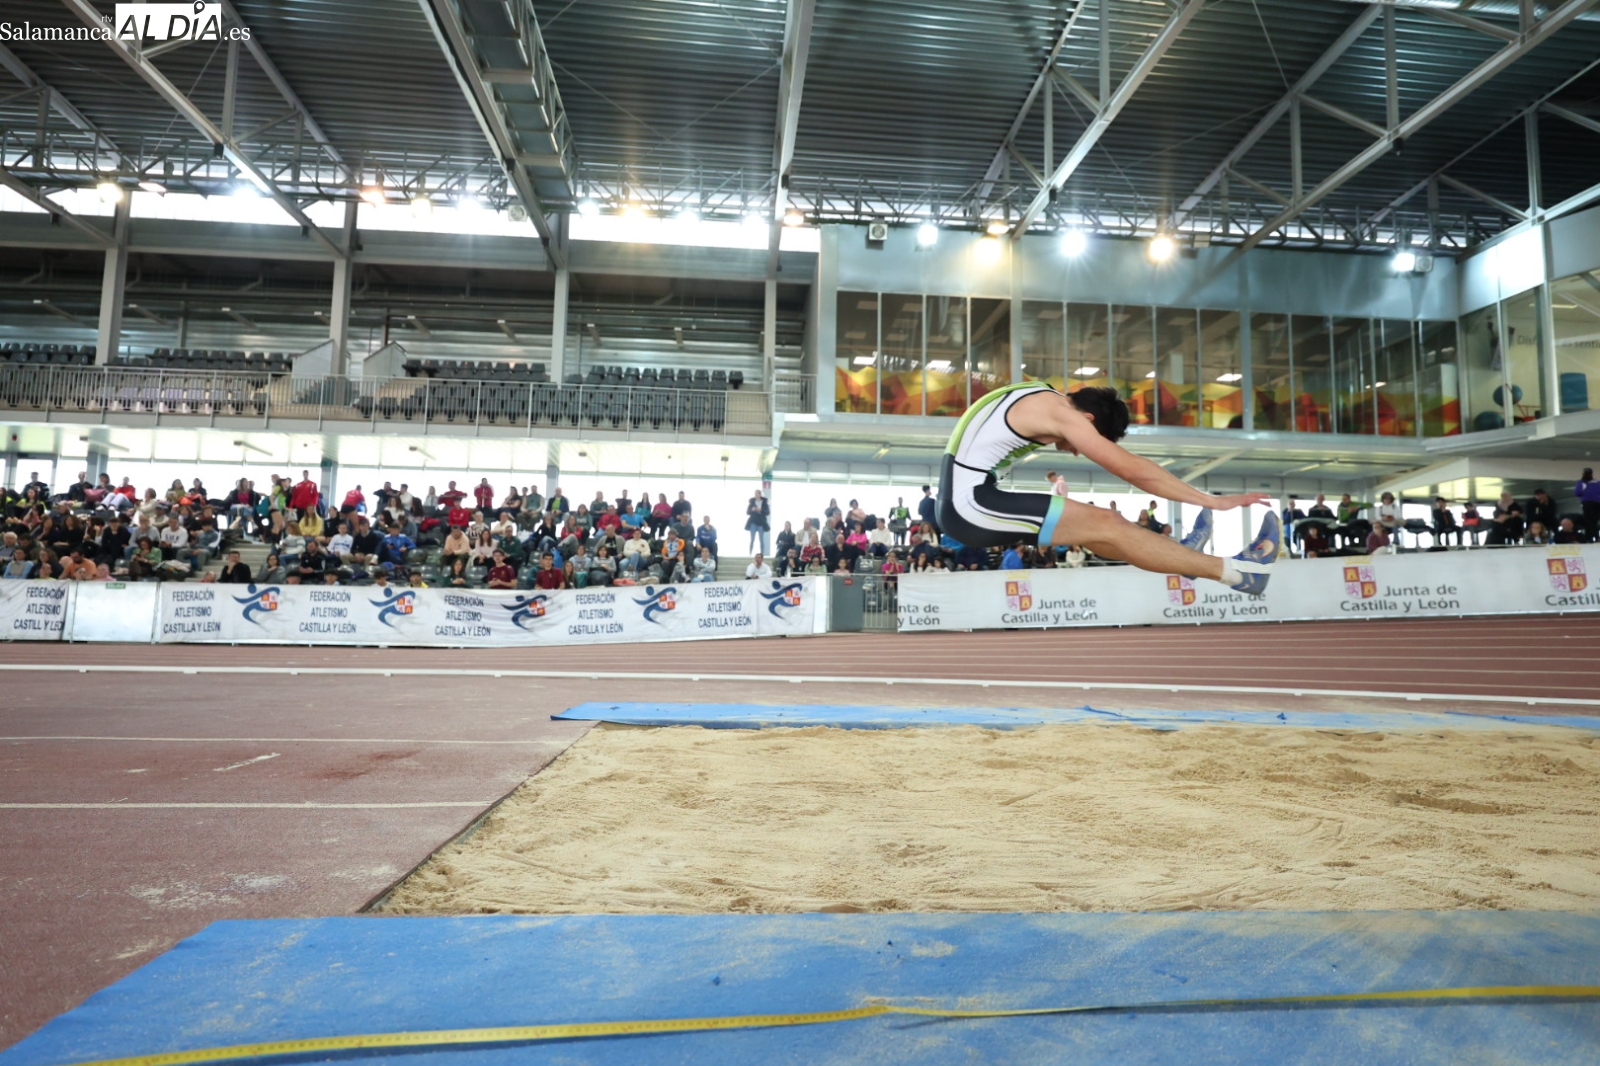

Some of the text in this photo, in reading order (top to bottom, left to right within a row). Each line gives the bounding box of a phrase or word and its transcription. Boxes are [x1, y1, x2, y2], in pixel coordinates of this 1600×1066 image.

[172, 588, 215, 602] FEDERACIÓN
[309, 589, 351, 602] FEDERACIÓN
[704, 585, 743, 598] FEDERACIÓN
[1383, 584, 1458, 597] Junta de
[444, 595, 484, 607] FEDERACIÓN
[576, 591, 616, 604] FEDERACIÓN
[1037, 598, 1096, 610] Junta de
[1202, 593, 1242, 604] Junta
[1545, 593, 1600, 606] Castill
[707, 601, 742, 612] ATLETISMO
[898, 604, 940, 613] nta de
[1340, 596, 1460, 613] Castilla y León
[174, 606, 211, 618] ATLETISMO
[311, 607, 348, 618] ATLETISMO
[446, 611, 482, 622] ATLETISMO
[578, 608, 614, 620] ATLETISMO
[1001, 609, 1098, 625] Castilla y León
[1163, 604, 1268, 619] Castilla y León
[163, 619, 221, 634] CASTILLA Y LEÓN
[299, 620, 357, 633] CASTILLA Y LEÓN
[698, 614, 752, 628] CASTILLA Y LEÓN
[909, 614, 940, 626] León
[435, 624, 492, 637] CASTILLA Y LEÓN
[568, 621, 624, 635] CASTILLA Y LEÓN
